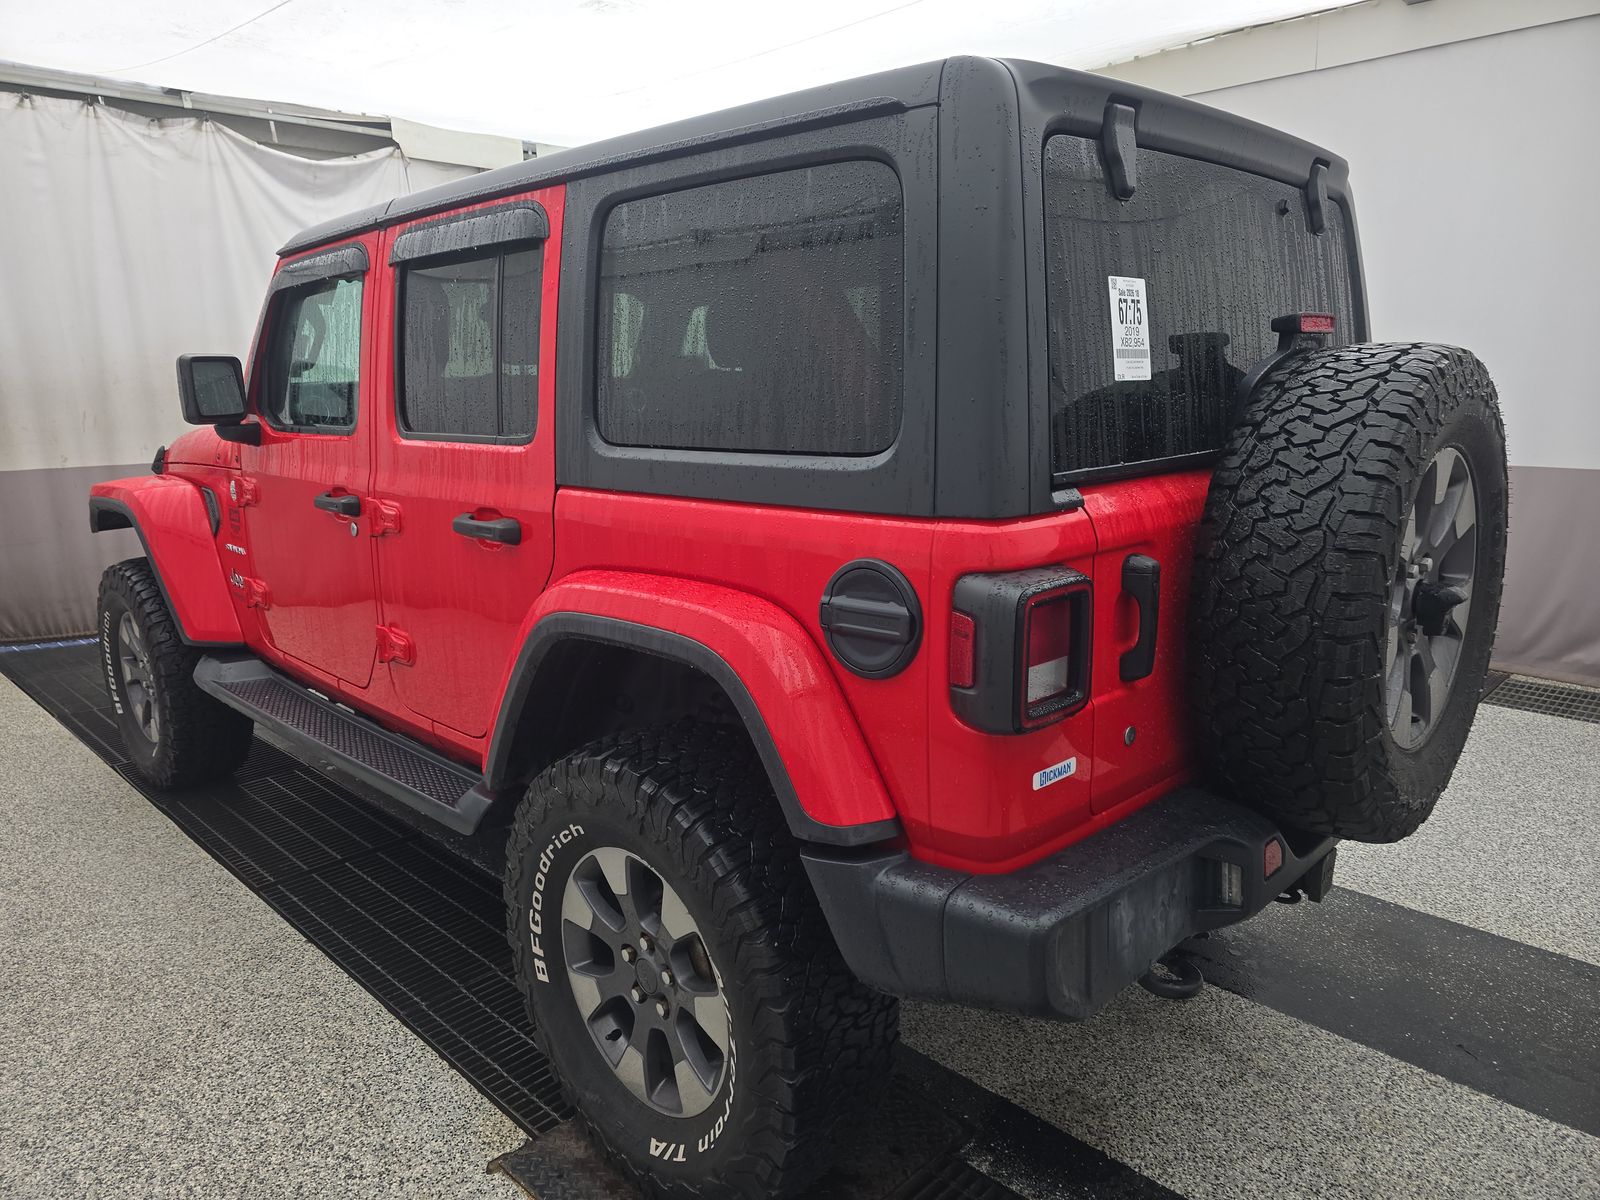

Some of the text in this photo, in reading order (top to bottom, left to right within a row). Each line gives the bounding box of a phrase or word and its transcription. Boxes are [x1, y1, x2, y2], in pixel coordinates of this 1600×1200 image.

[1118, 298, 1142, 325] 67:75
[1124, 326, 1140, 336] 2019
[103, 610, 123, 714] BFGoodrich
[528, 823, 585, 983] BFGoodrich
[649, 1136, 687, 1163] T/A
